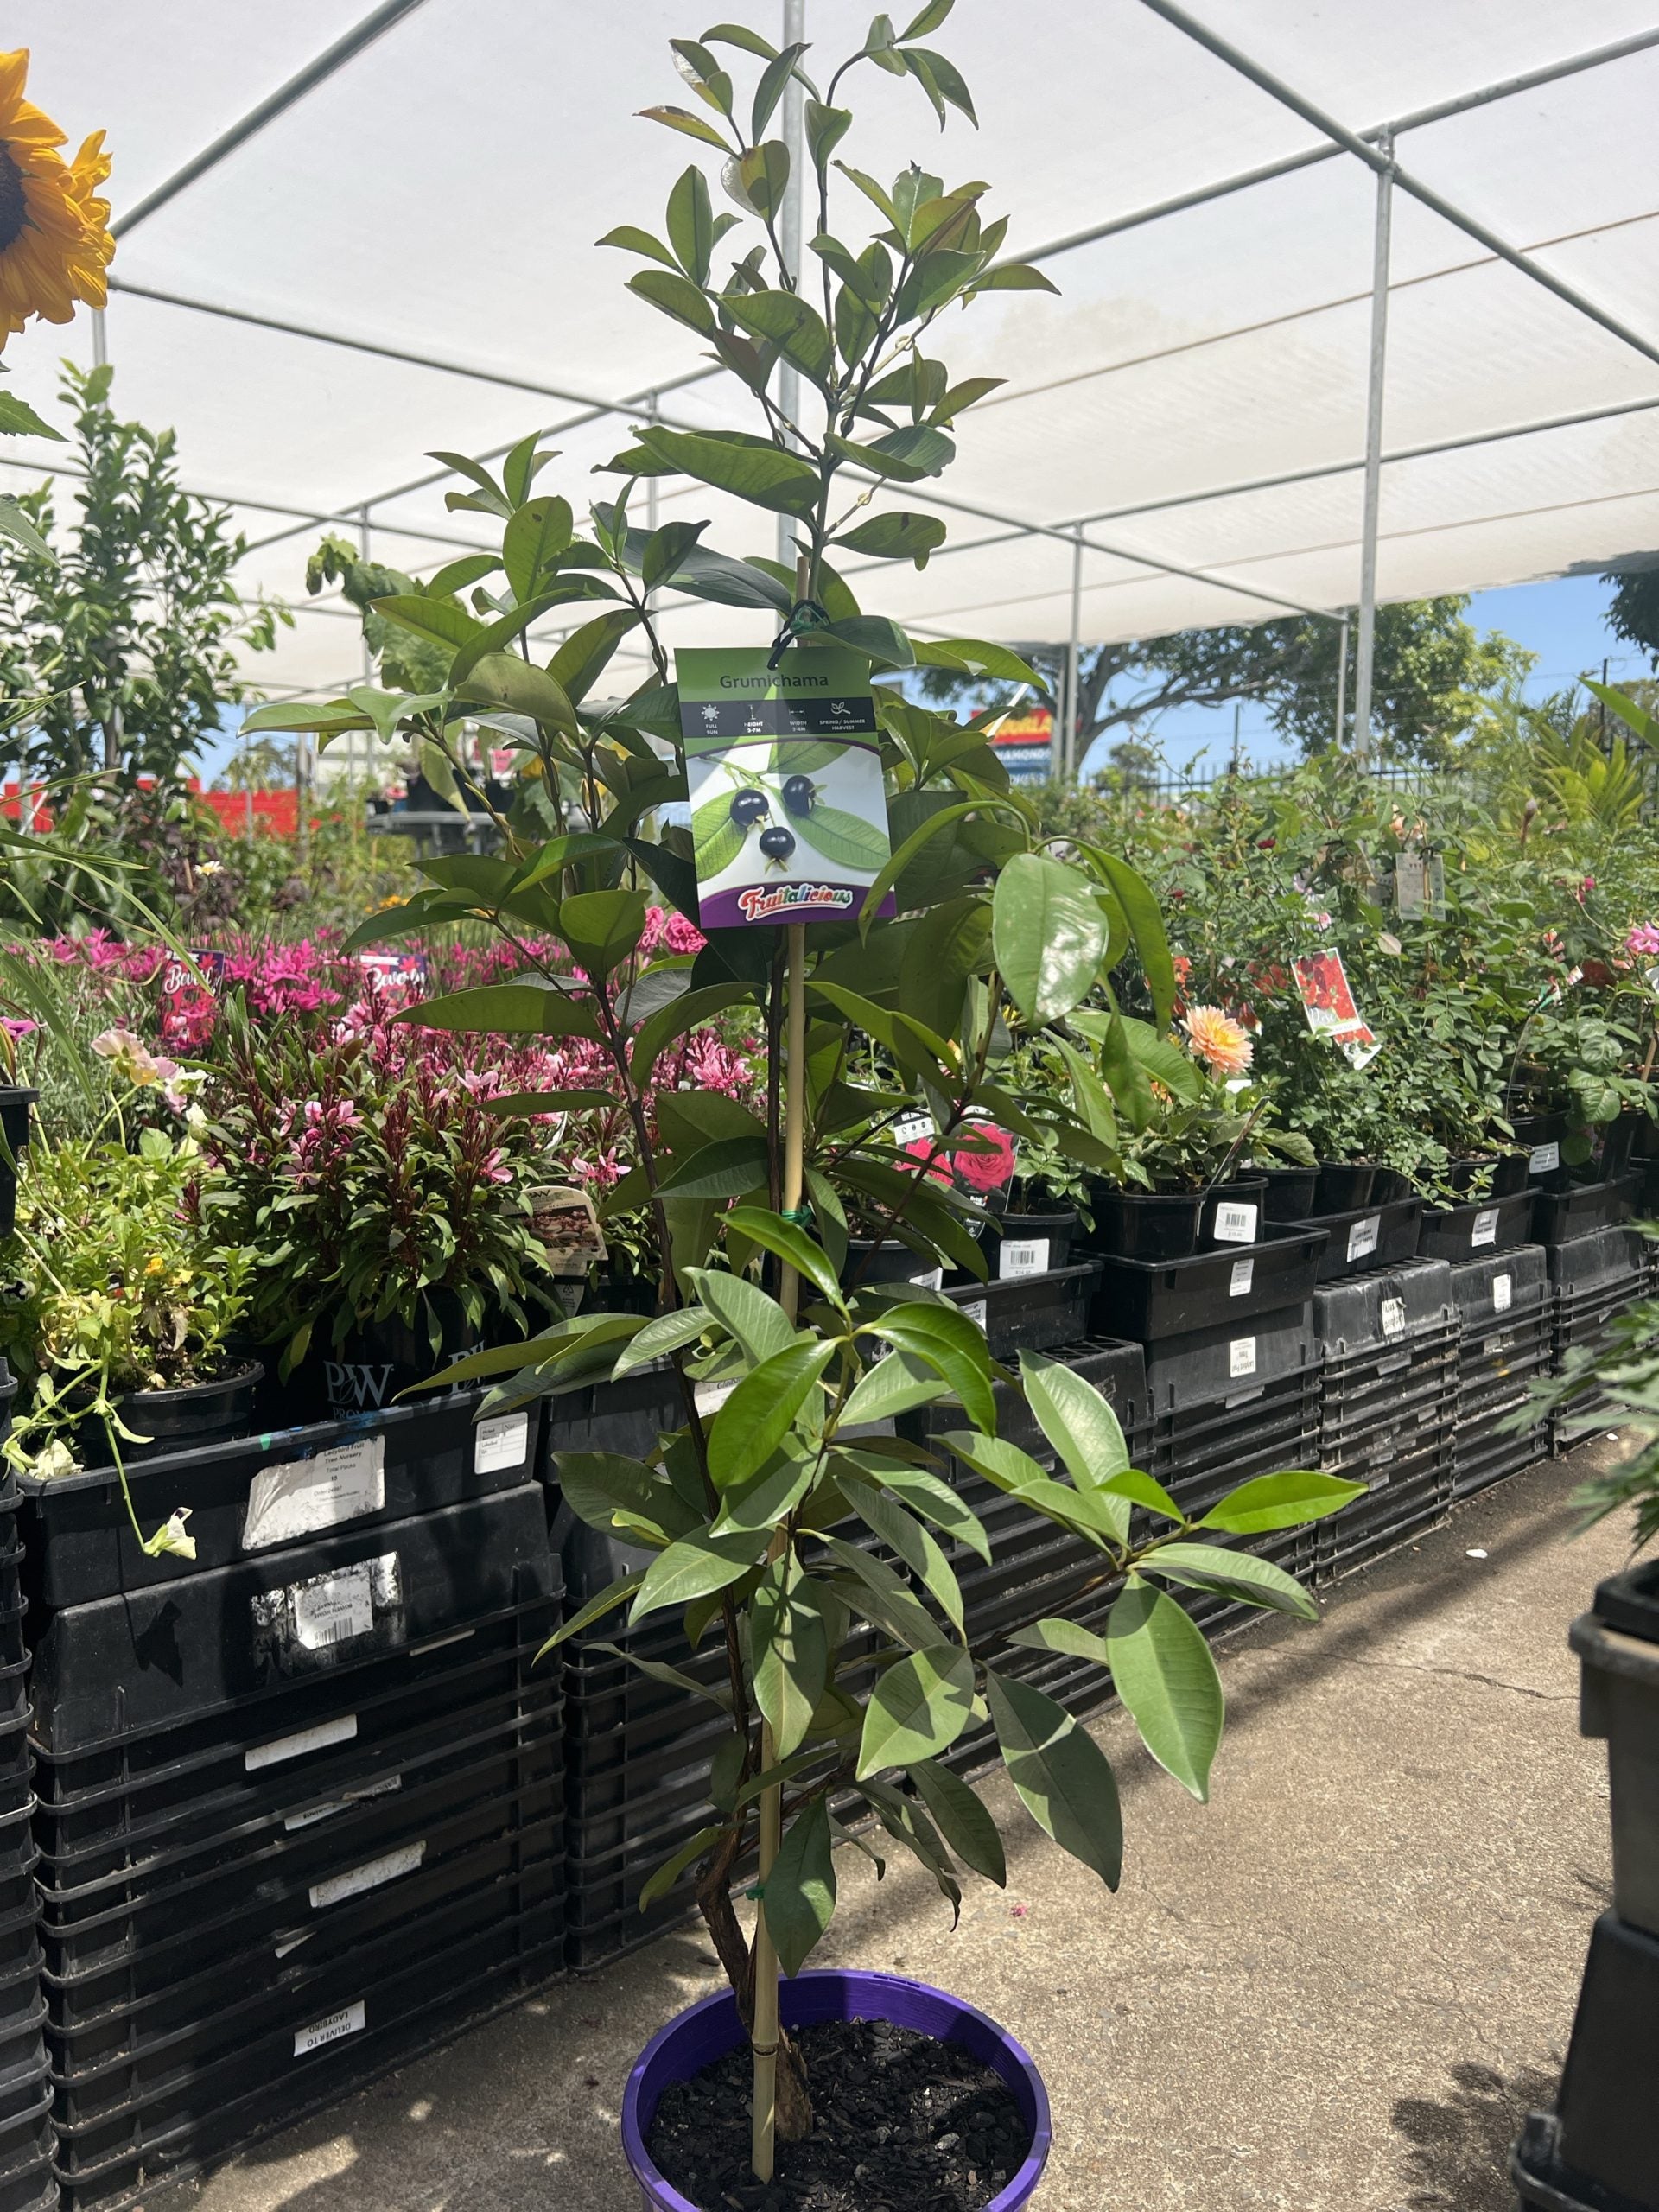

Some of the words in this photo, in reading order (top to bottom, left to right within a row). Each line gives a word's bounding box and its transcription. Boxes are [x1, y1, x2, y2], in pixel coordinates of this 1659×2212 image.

[720, 673, 830, 690] Grumichama
[739, 885, 852, 920] Fruitalicious
[323, 1360, 394, 1407] PW
[339, 1451, 362, 1461] Nursery
[308, 2012, 348, 2033] LADYBIRD
[307, 2037, 318, 2047] TO
[320, 2023, 351, 2042] DELIVER
